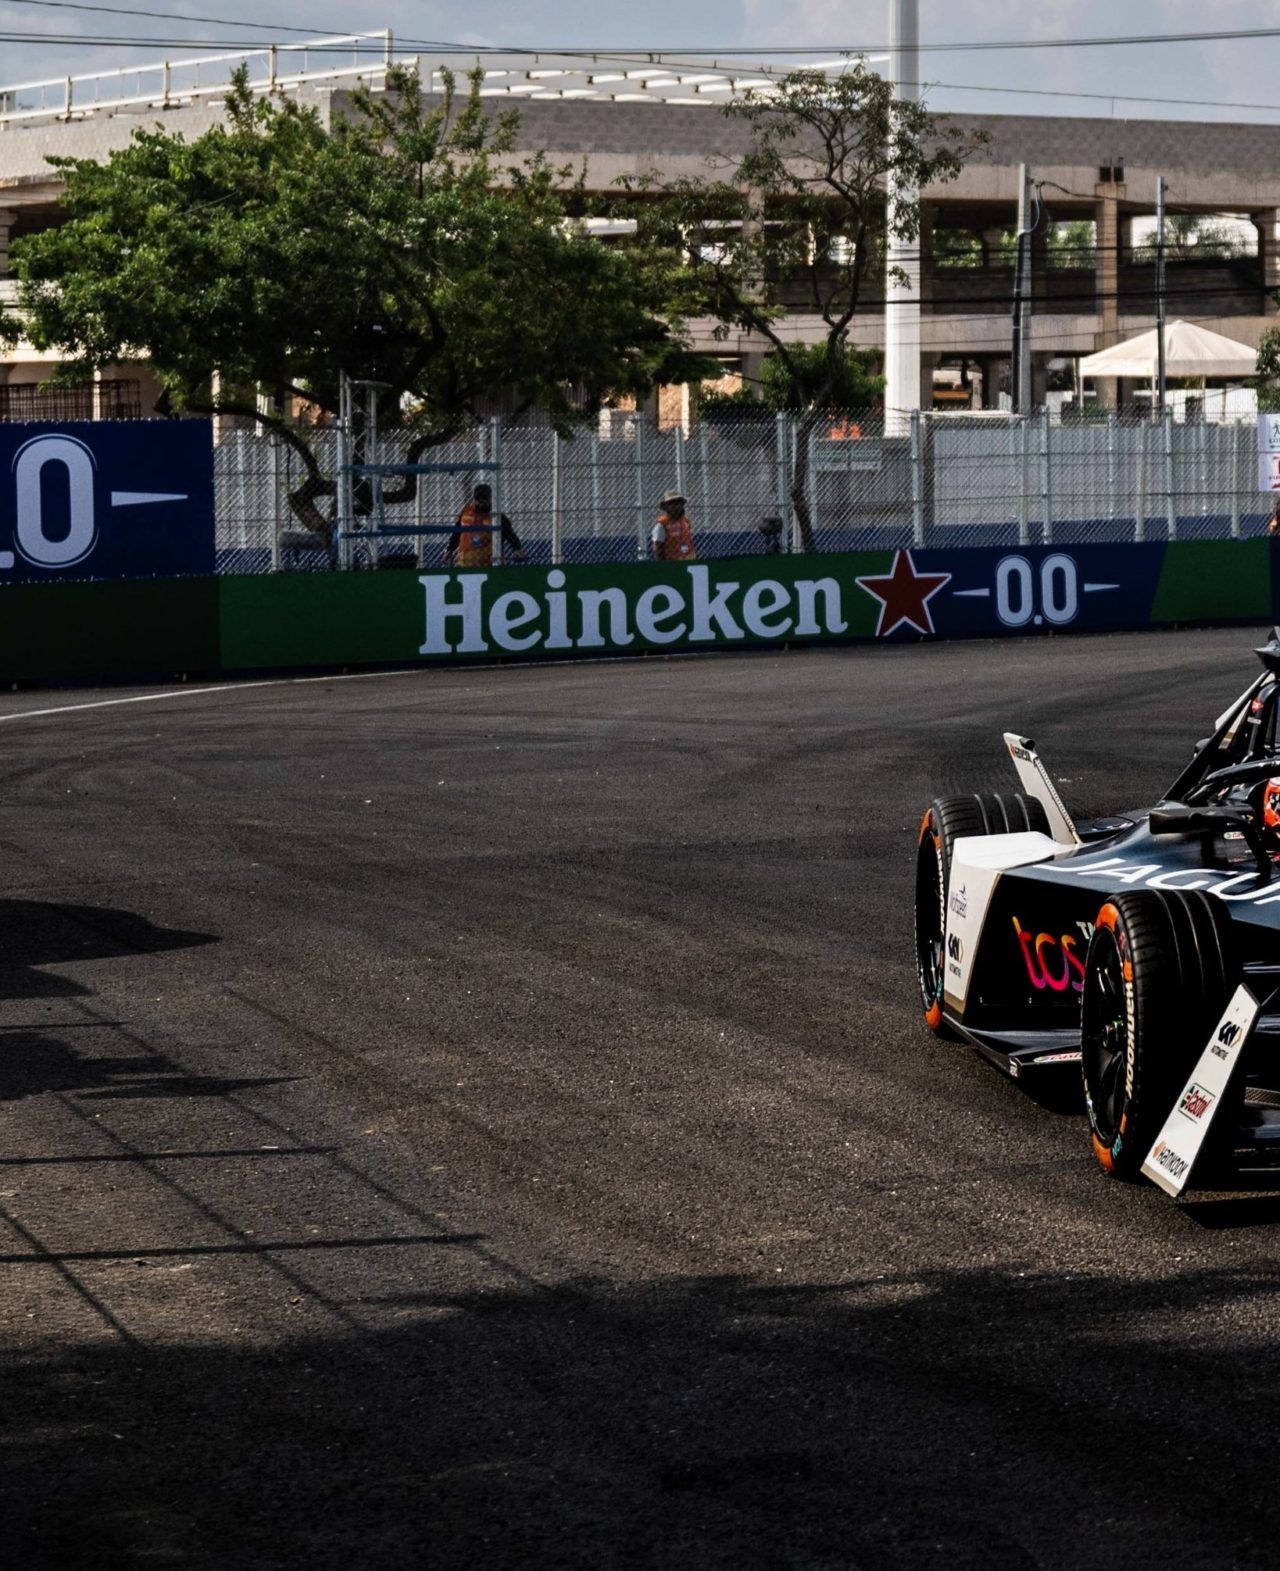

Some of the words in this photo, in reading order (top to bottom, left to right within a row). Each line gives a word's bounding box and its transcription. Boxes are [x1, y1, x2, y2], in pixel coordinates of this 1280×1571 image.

[419, 565, 848, 654] Heineken
[995, 553, 1079, 627] 0.0
[1012, 916, 1086, 992] tcs
